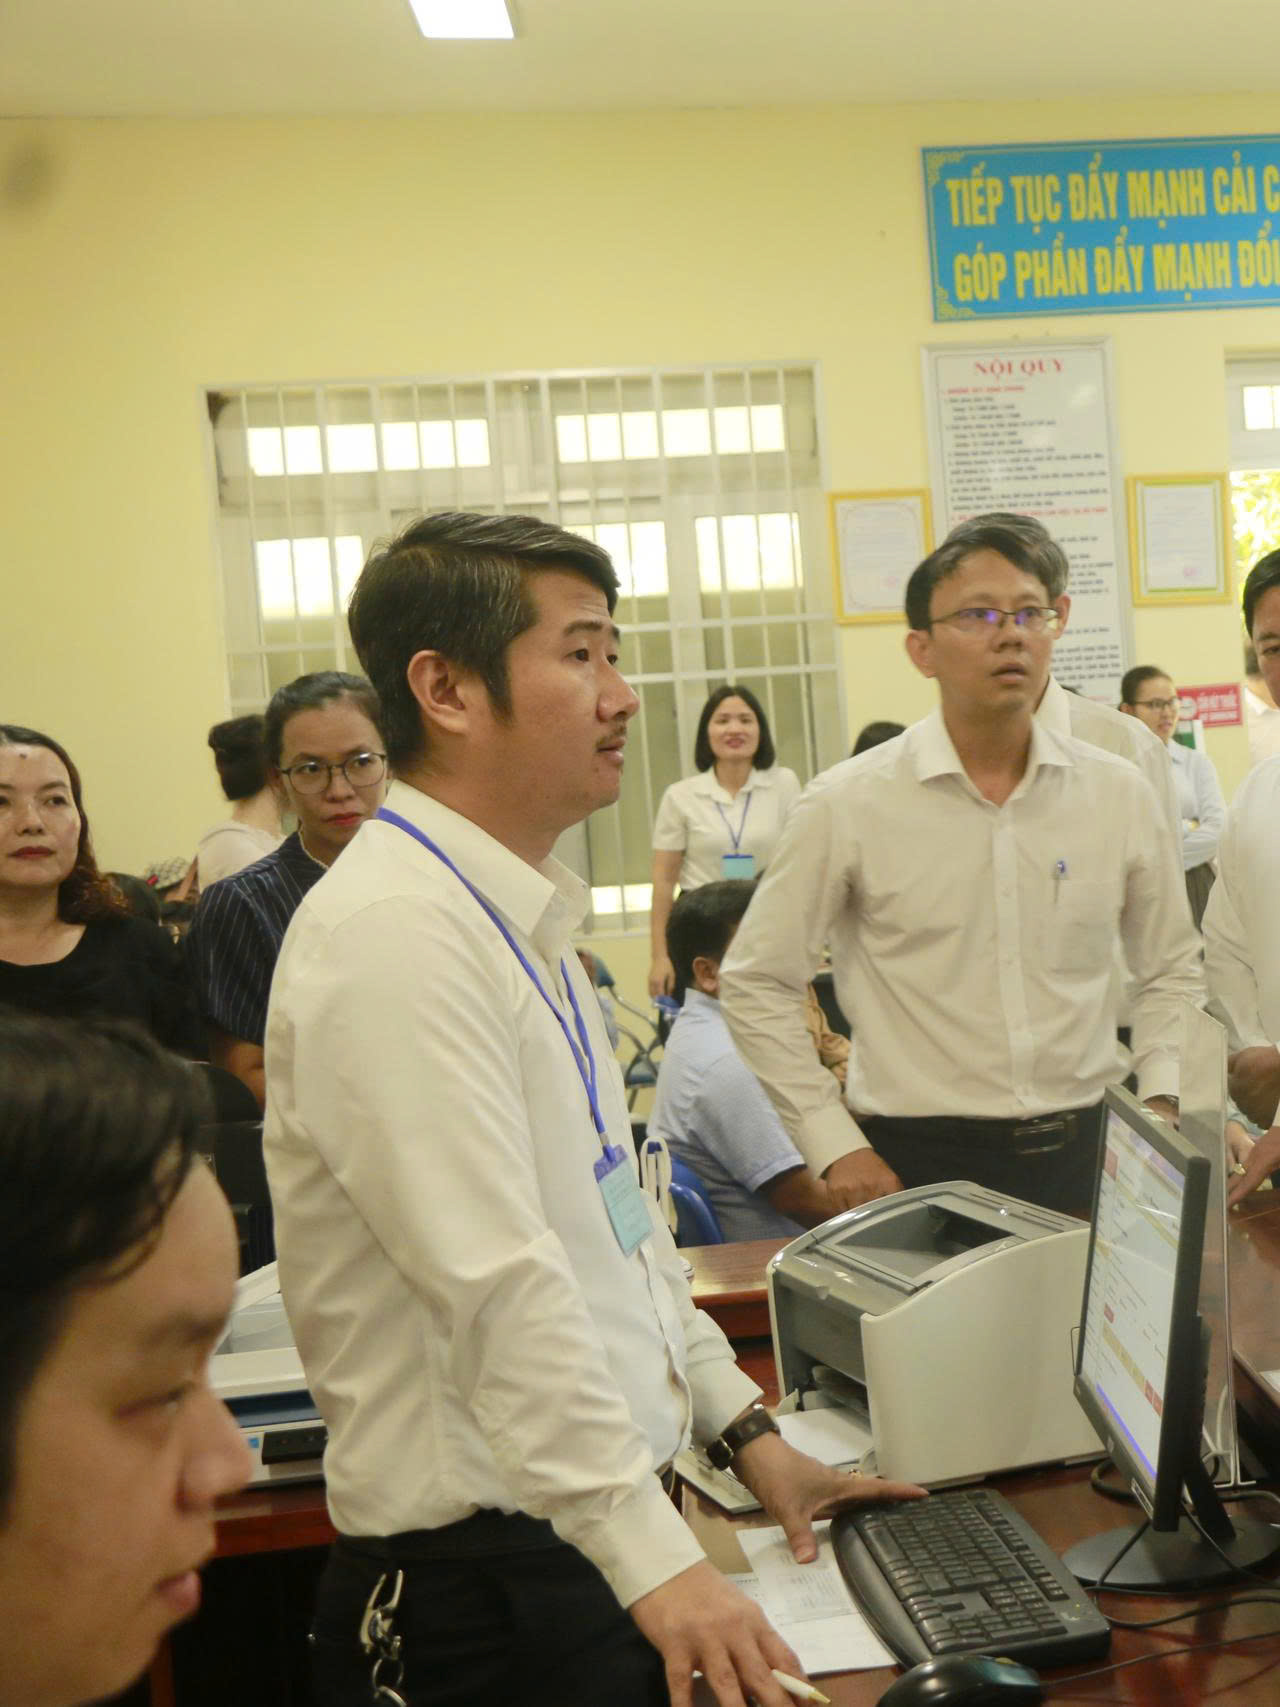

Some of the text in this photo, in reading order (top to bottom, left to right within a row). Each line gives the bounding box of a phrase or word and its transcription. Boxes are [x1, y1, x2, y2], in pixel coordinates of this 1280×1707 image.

[945, 161, 1003, 226] TIẾP
[1010, 174, 1063, 234] TỤC
[1068, 152, 1119, 221] ĐẨY
[1126, 168, 1207, 229] MẠNH
[1213, 152, 1256, 214] CẢI
[954, 243, 1008, 302] GÓP
[1094, 226, 1144, 294] ĐẨY
[1152, 240, 1232, 301] MẠNH
[974, 355, 1064, 381] NỘI QUY
